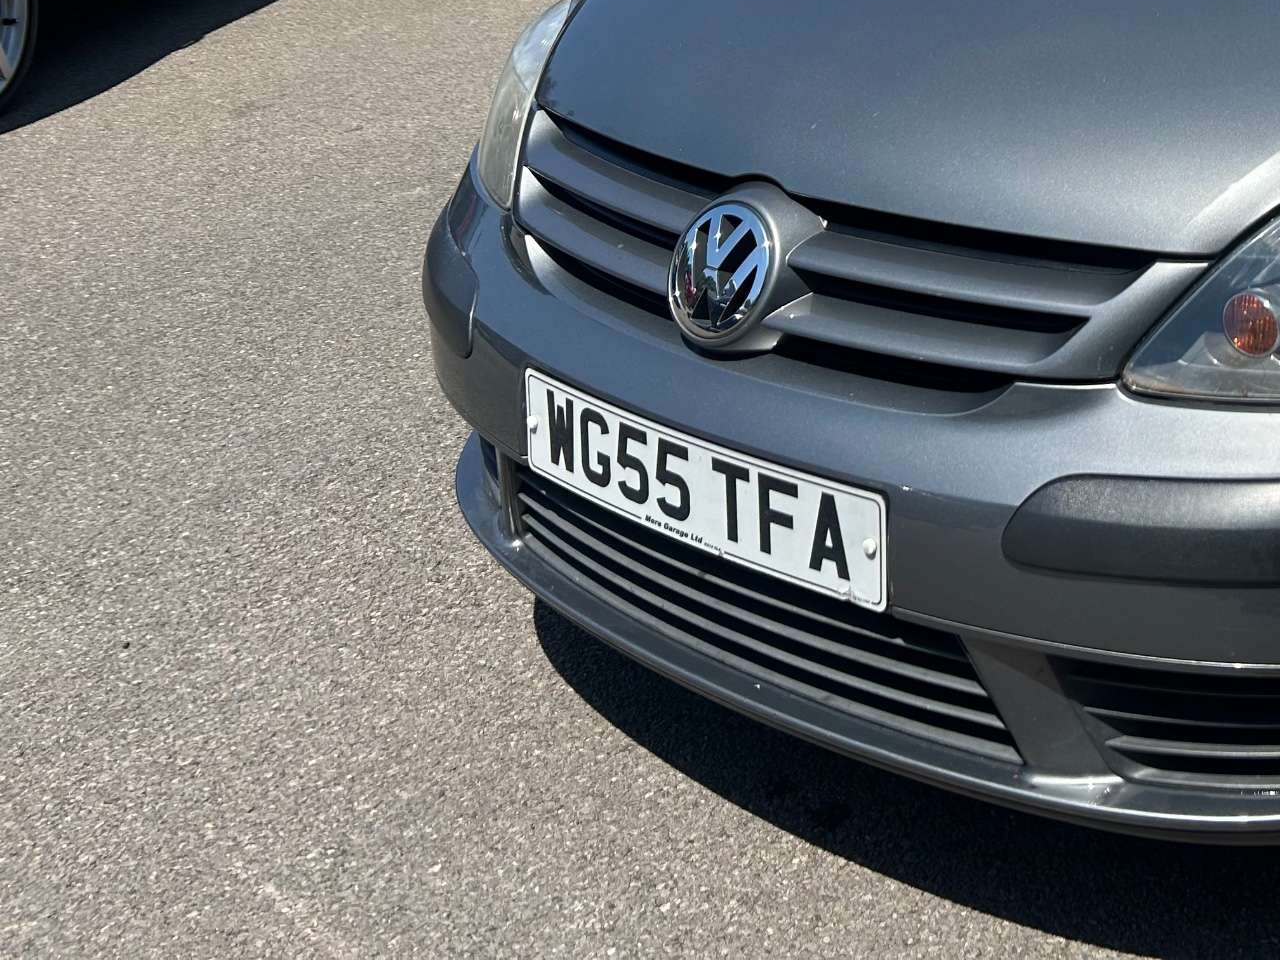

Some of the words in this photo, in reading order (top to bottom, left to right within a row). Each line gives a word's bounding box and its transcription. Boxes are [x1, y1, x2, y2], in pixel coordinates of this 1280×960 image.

[546, 388, 691, 522] WG55
[711, 456, 851, 581] TFA
[663, 522, 689, 538] Garage
[690, 533, 703, 544] Ltd
